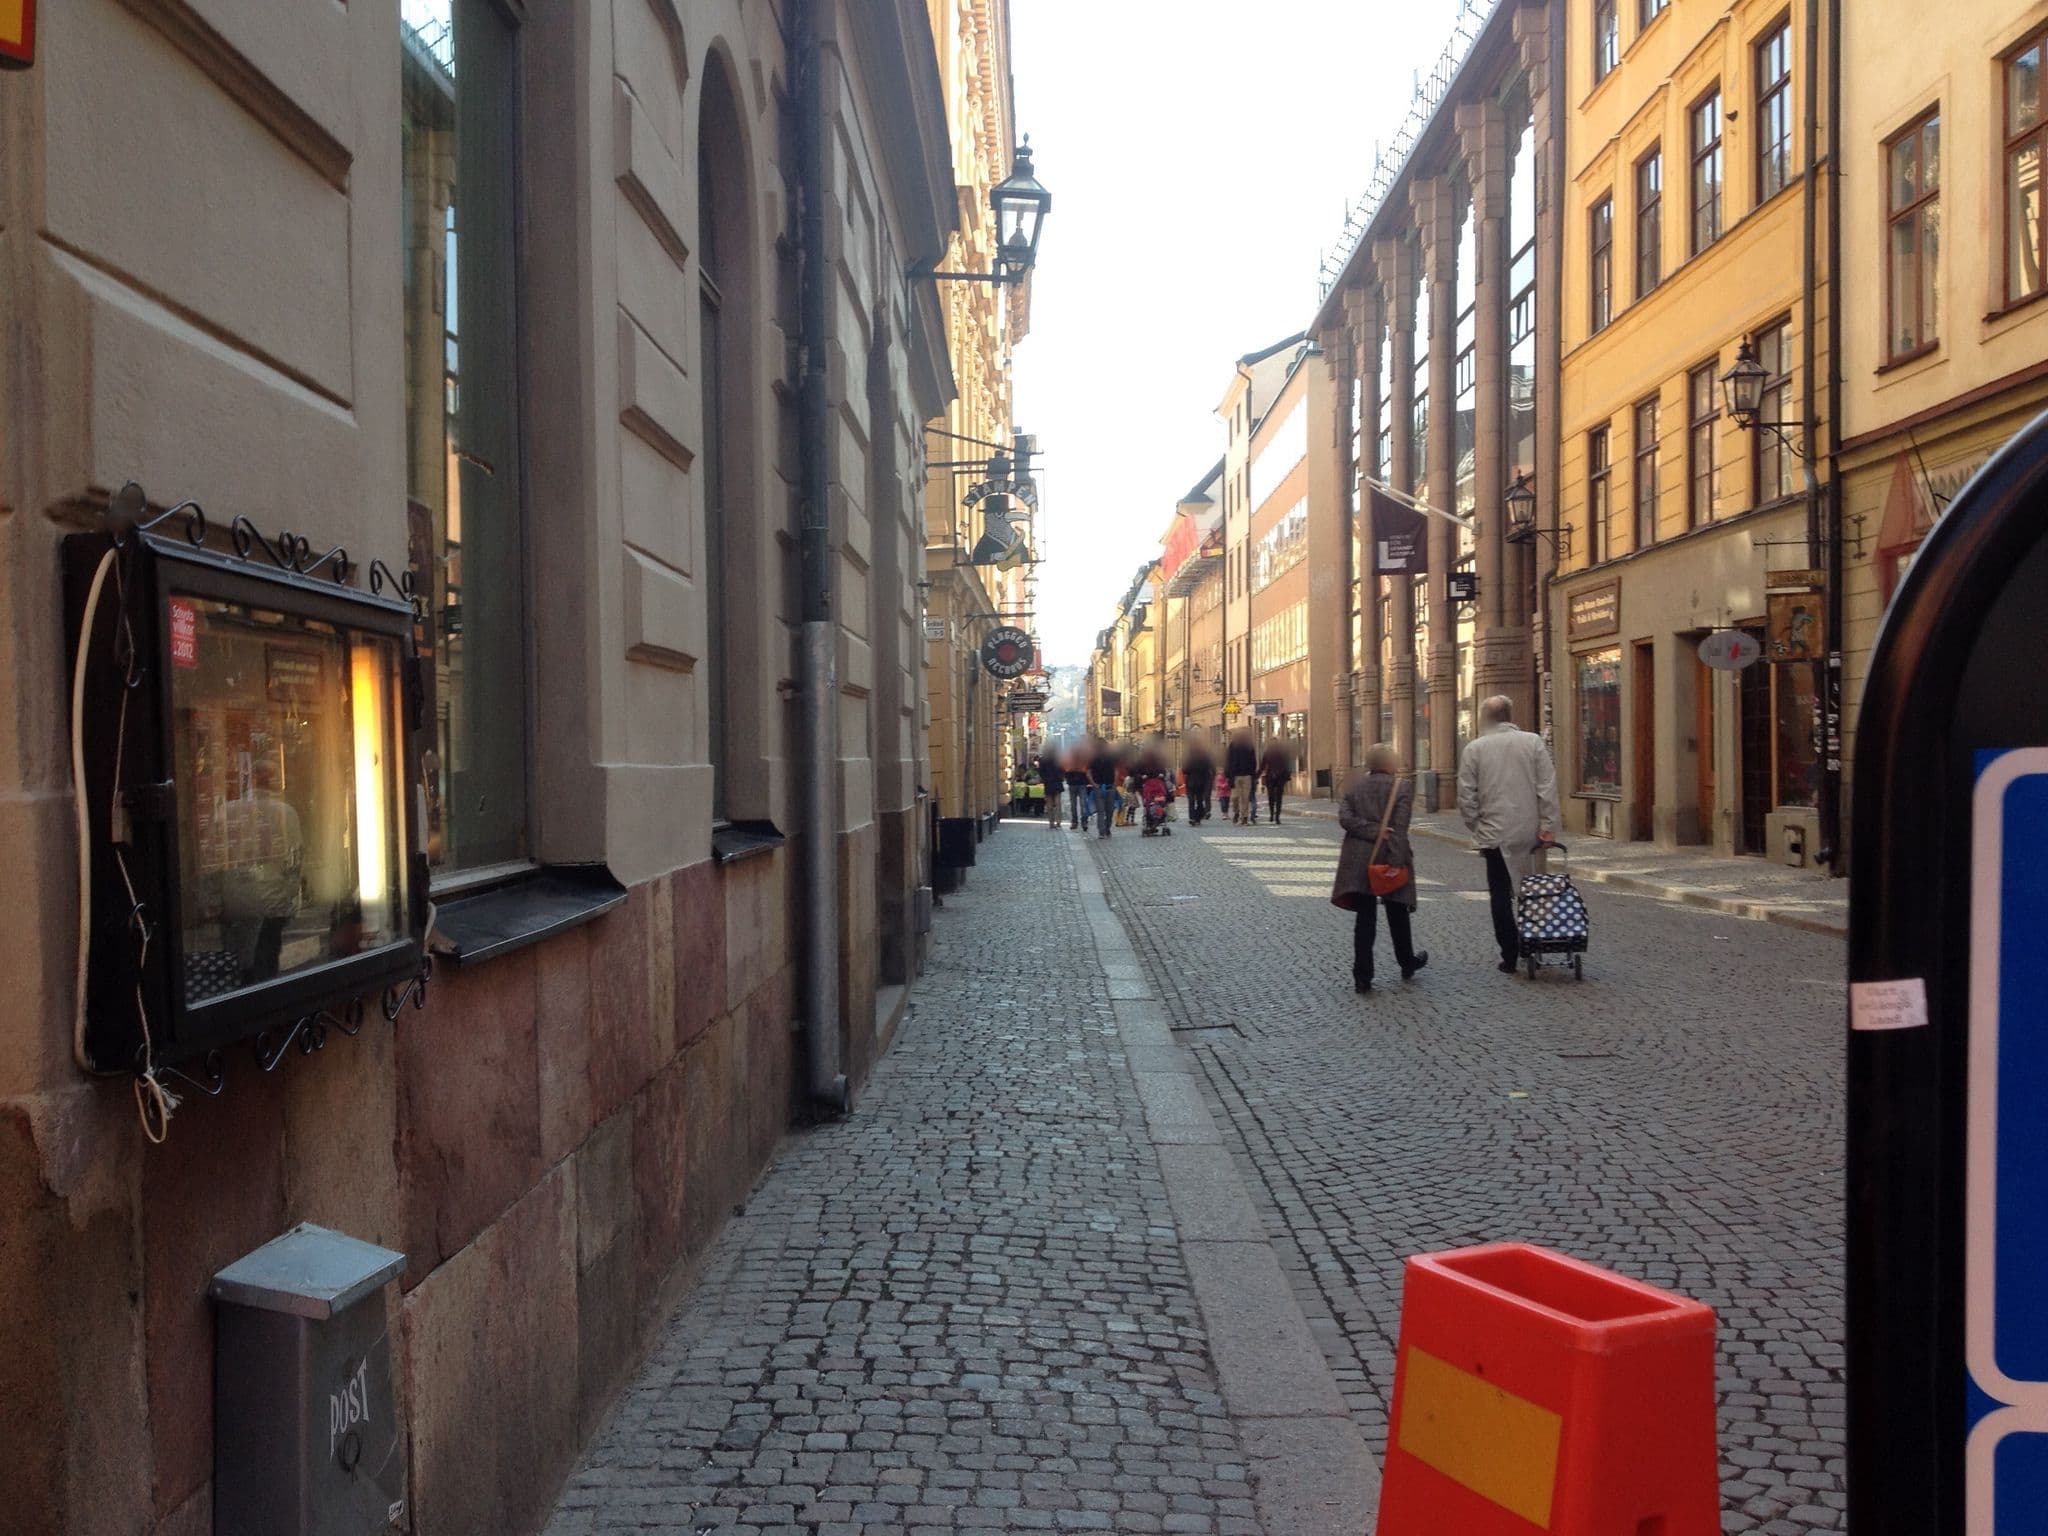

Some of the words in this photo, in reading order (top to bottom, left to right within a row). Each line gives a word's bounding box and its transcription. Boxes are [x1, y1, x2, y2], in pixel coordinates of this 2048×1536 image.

[963, 480, 1037, 507] STAMPEN
[987, 630, 1028, 649] PLUGGED
[987, 657, 1028, 675] RECORDS
[329, 1354, 370, 1463] POST
